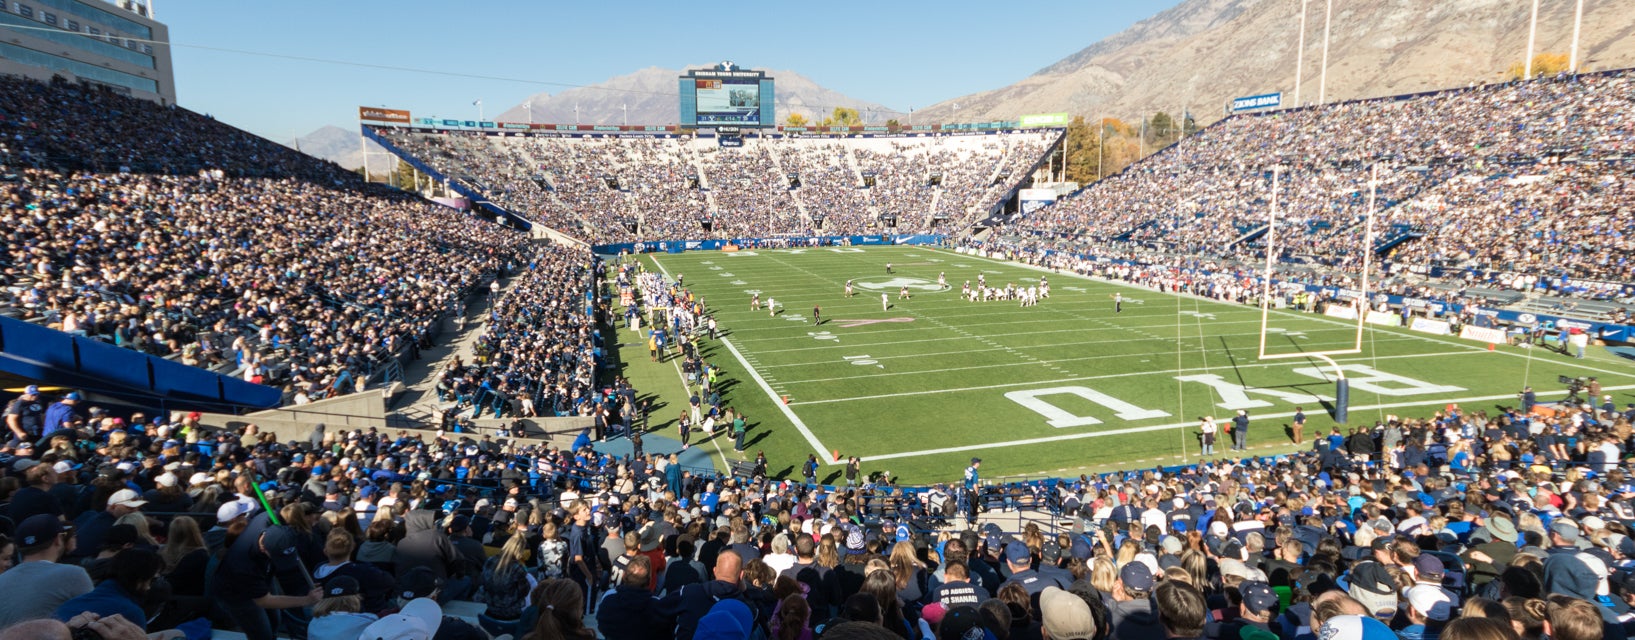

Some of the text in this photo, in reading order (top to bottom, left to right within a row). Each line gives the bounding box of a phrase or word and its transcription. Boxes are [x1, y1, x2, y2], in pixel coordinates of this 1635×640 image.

[1234, 95, 1279, 108] ZIONS BANK
[843, 355, 879, 366] 10
[1004, 364, 1468, 428] BYU
